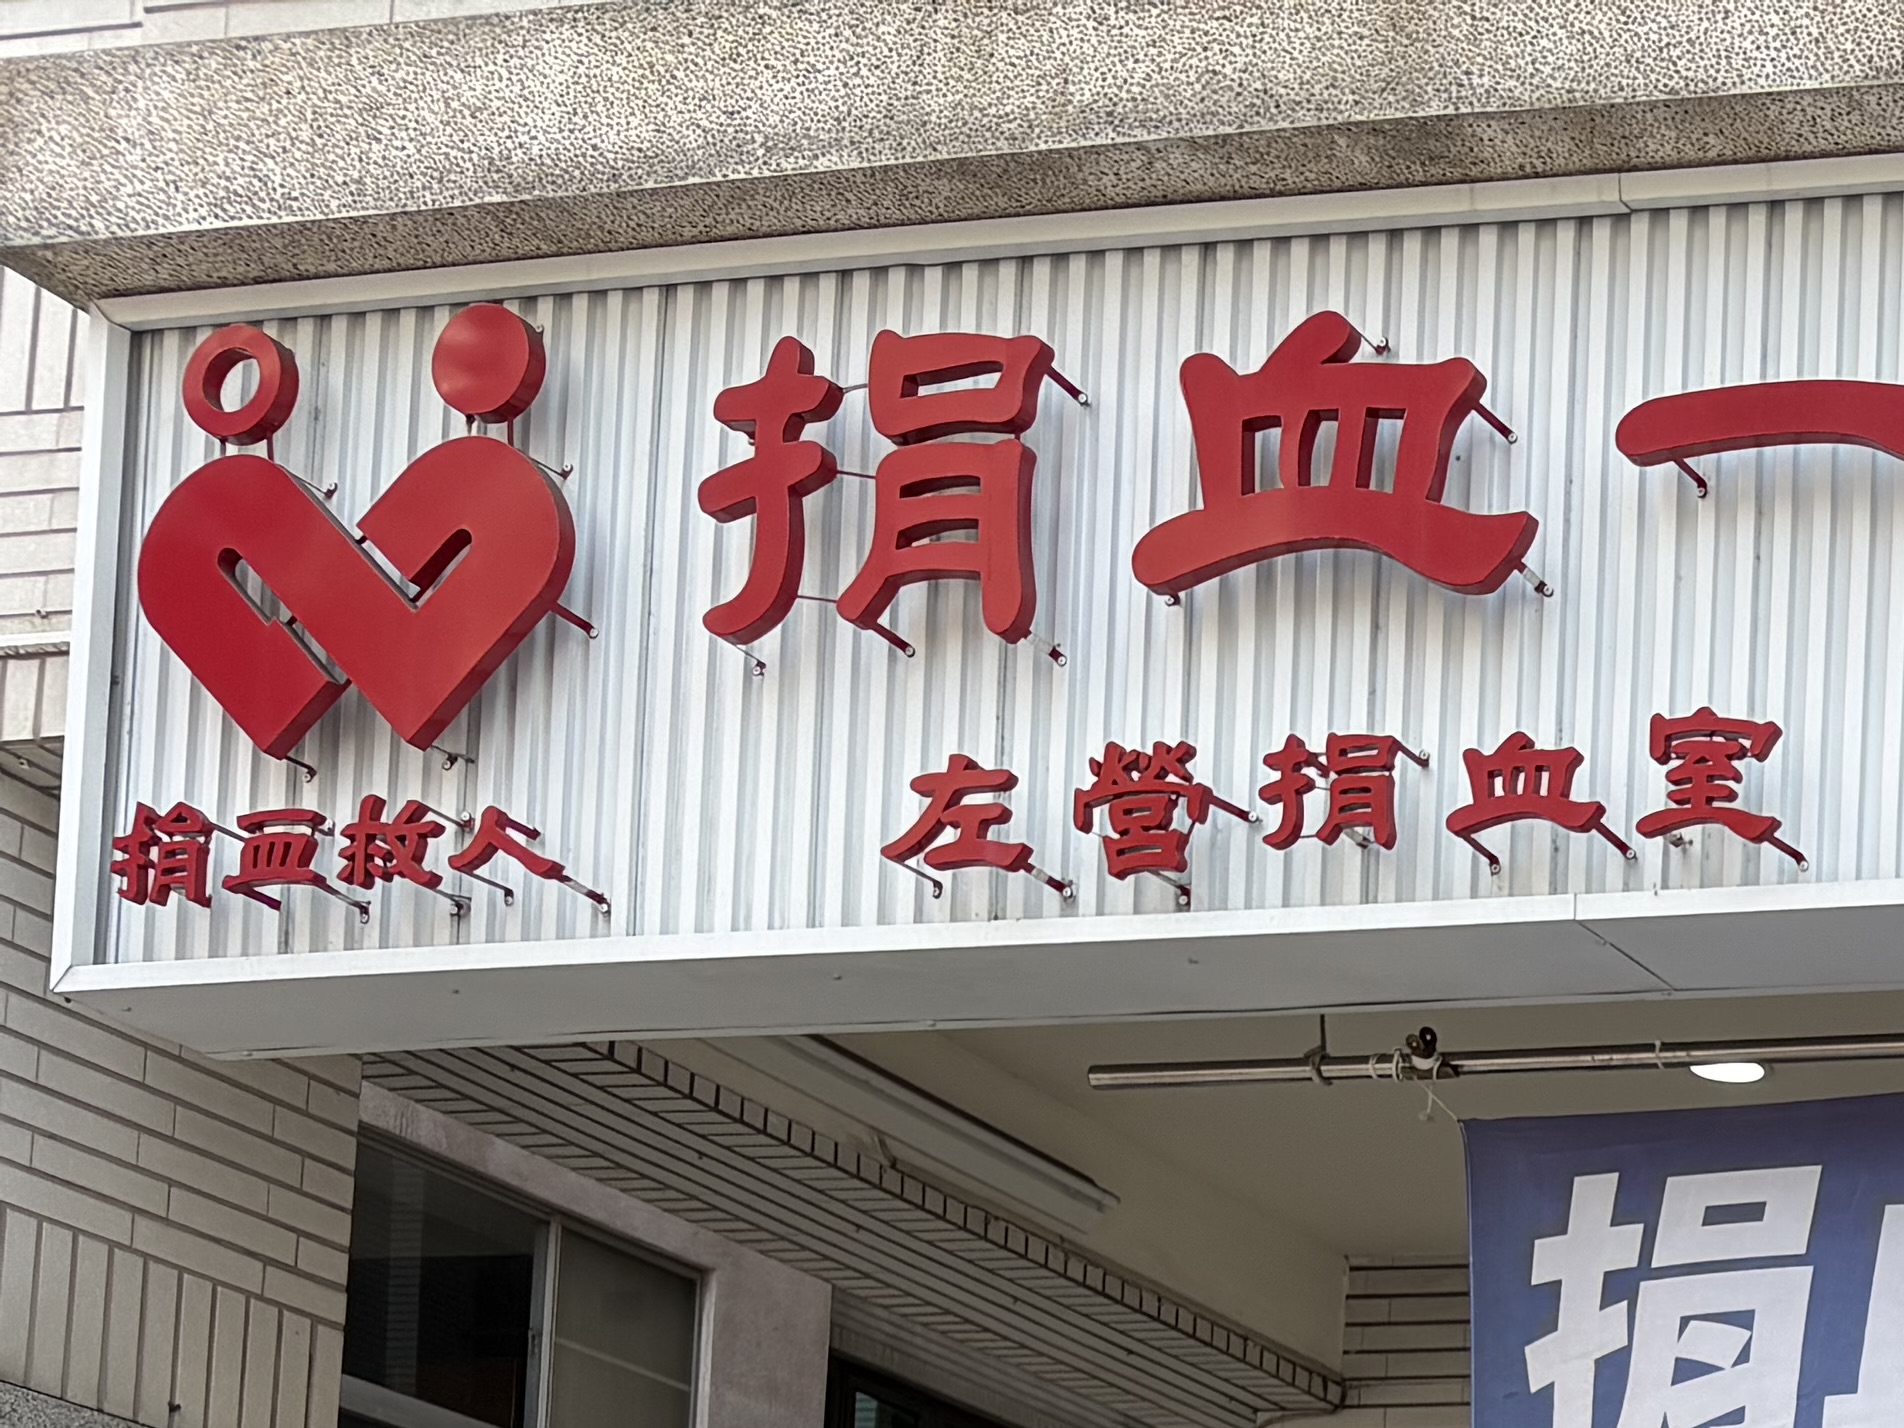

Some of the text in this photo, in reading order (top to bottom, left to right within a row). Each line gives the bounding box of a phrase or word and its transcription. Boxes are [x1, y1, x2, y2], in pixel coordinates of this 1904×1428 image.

[112, 794, 563, 909] 捐血救人
[881, 707, 1781, 882] 左營捐血室
